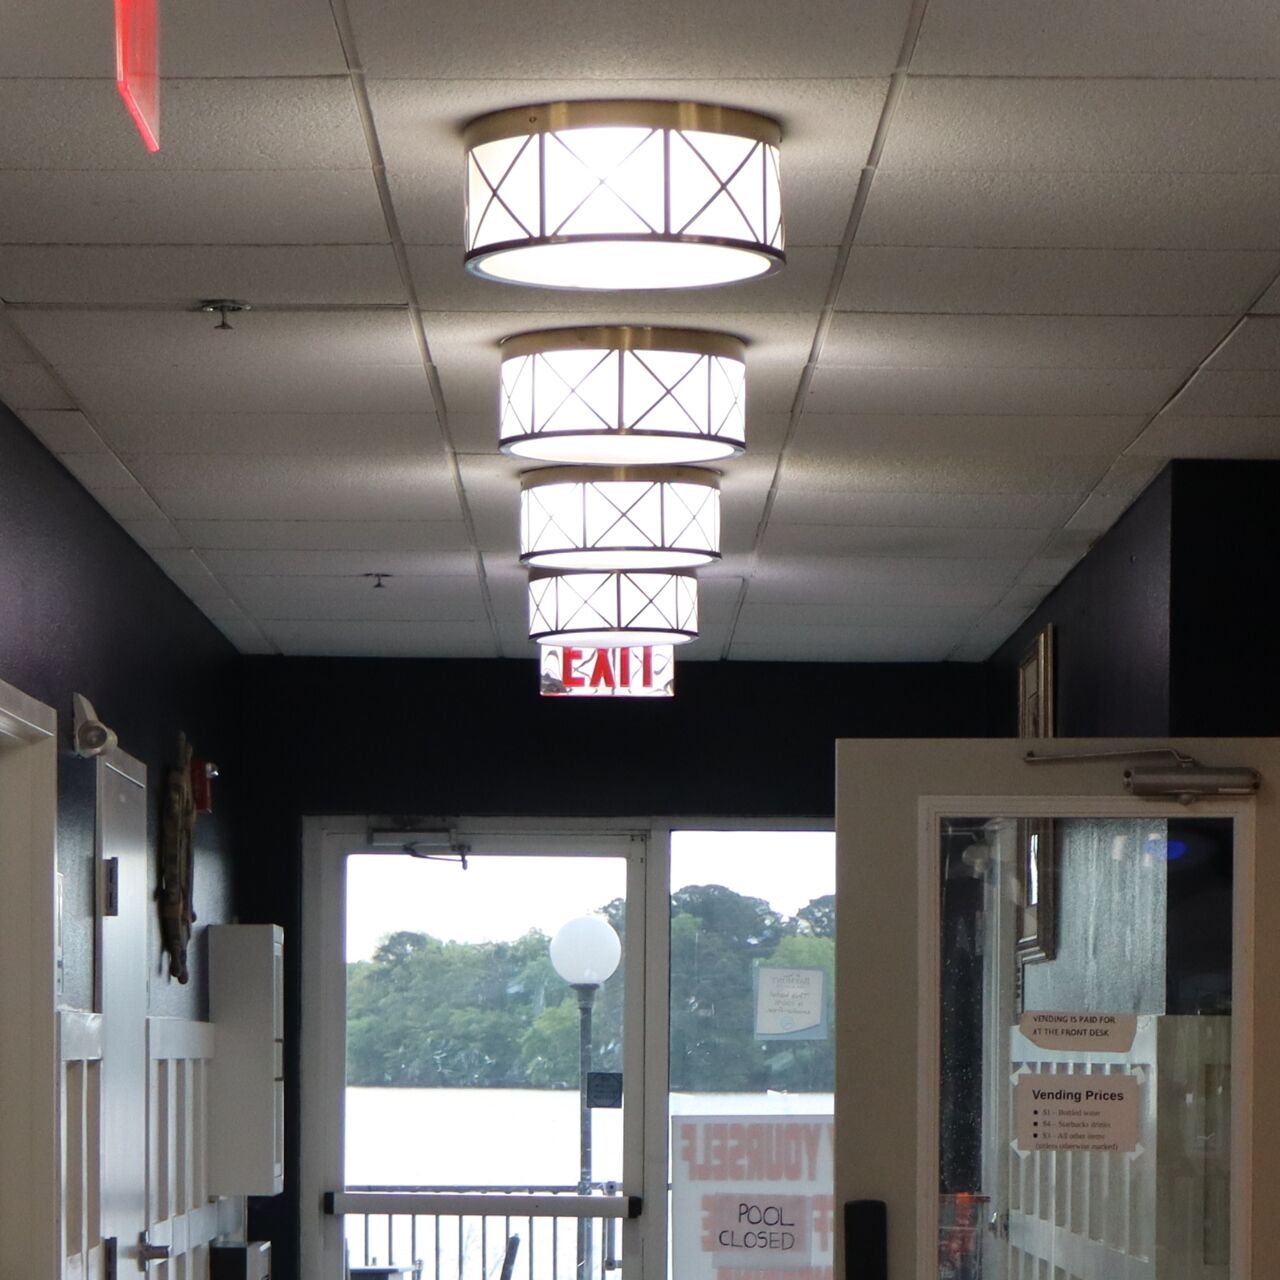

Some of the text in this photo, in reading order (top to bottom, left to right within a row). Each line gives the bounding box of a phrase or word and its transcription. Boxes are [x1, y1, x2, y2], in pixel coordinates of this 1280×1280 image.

[1033, 1015, 1116, 1024] VENDING IS PAID FOR
[1033, 1028, 1109, 1037] AT THE FRONT DESK
[1032, 1089, 1125, 1102] Vending Prices
[738, 1203, 795, 1227] POOL
[718, 1230, 796, 1250] CLOSED
